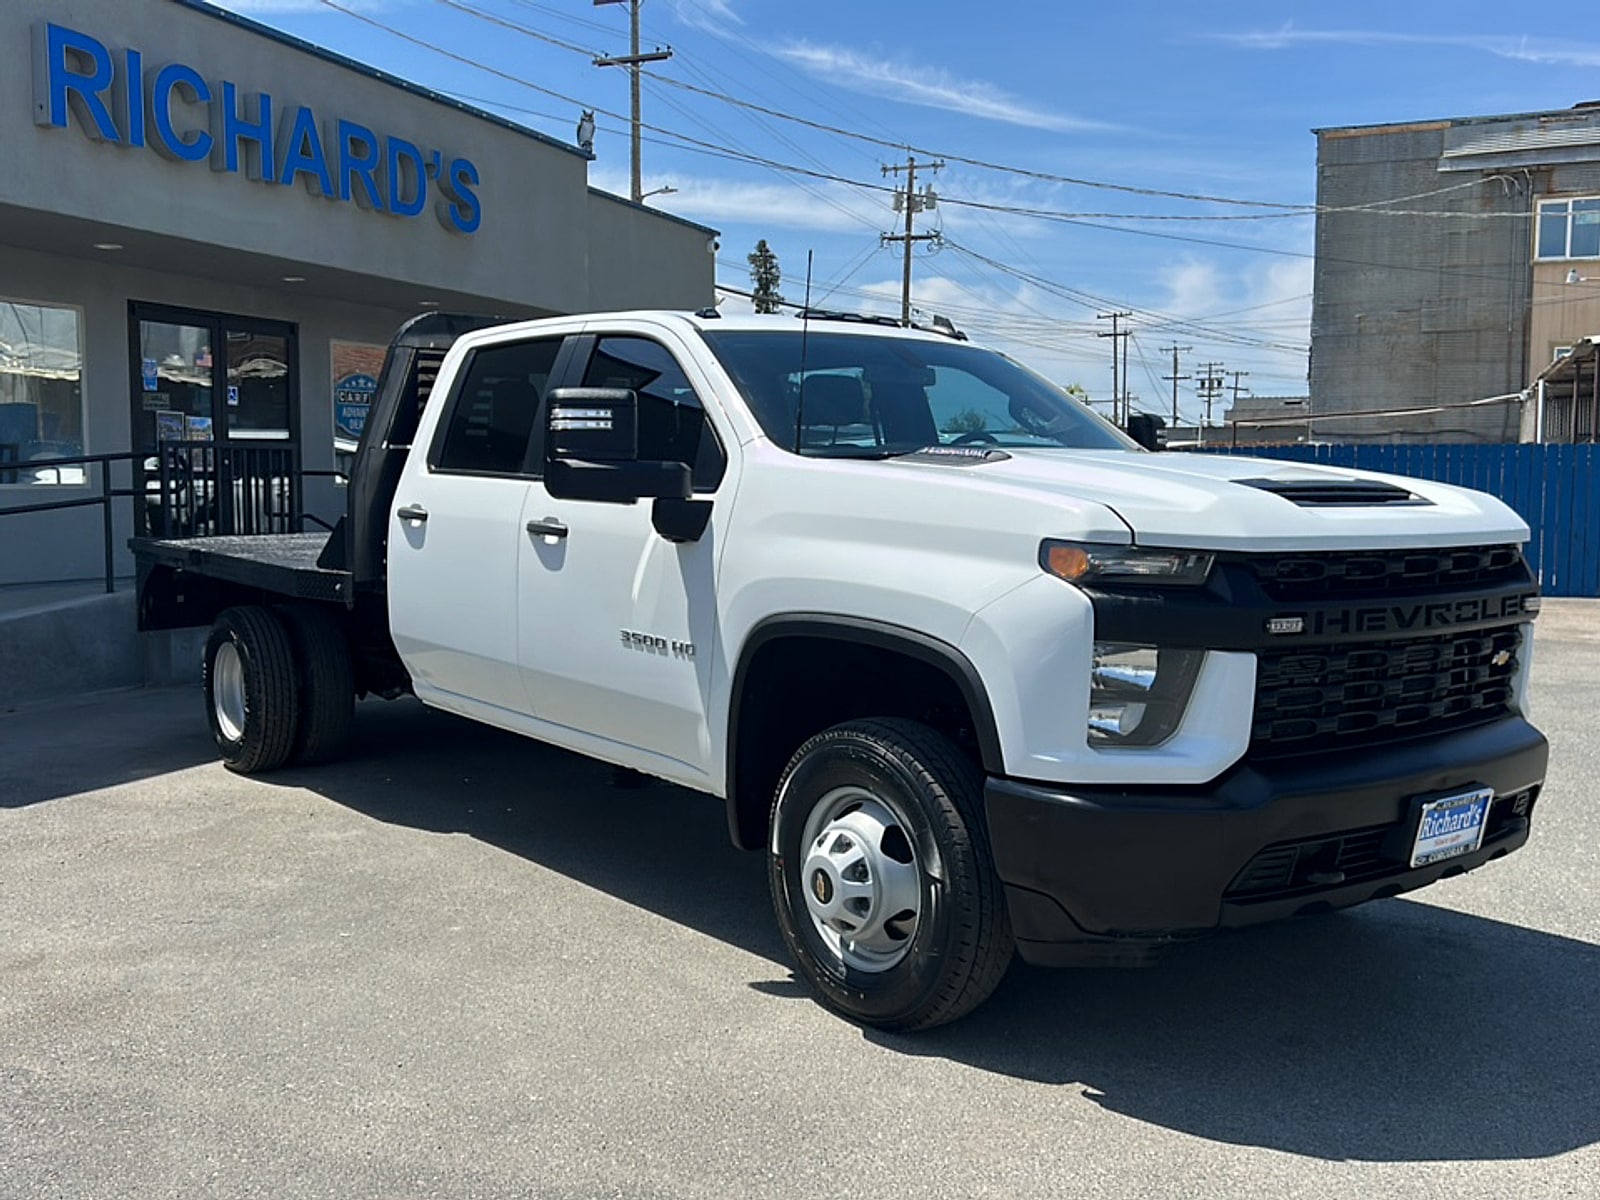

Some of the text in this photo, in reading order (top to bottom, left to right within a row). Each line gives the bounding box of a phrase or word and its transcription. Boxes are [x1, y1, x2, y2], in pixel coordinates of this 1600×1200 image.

[45, 21, 482, 234] RICHARD'S
[339, 390, 369, 403] CARF
[1275, 592, 1537, 635] HEVROLE
[620, 628, 697, 656] 3500 HD
[1421, 803, 1482, 838] Richard's
